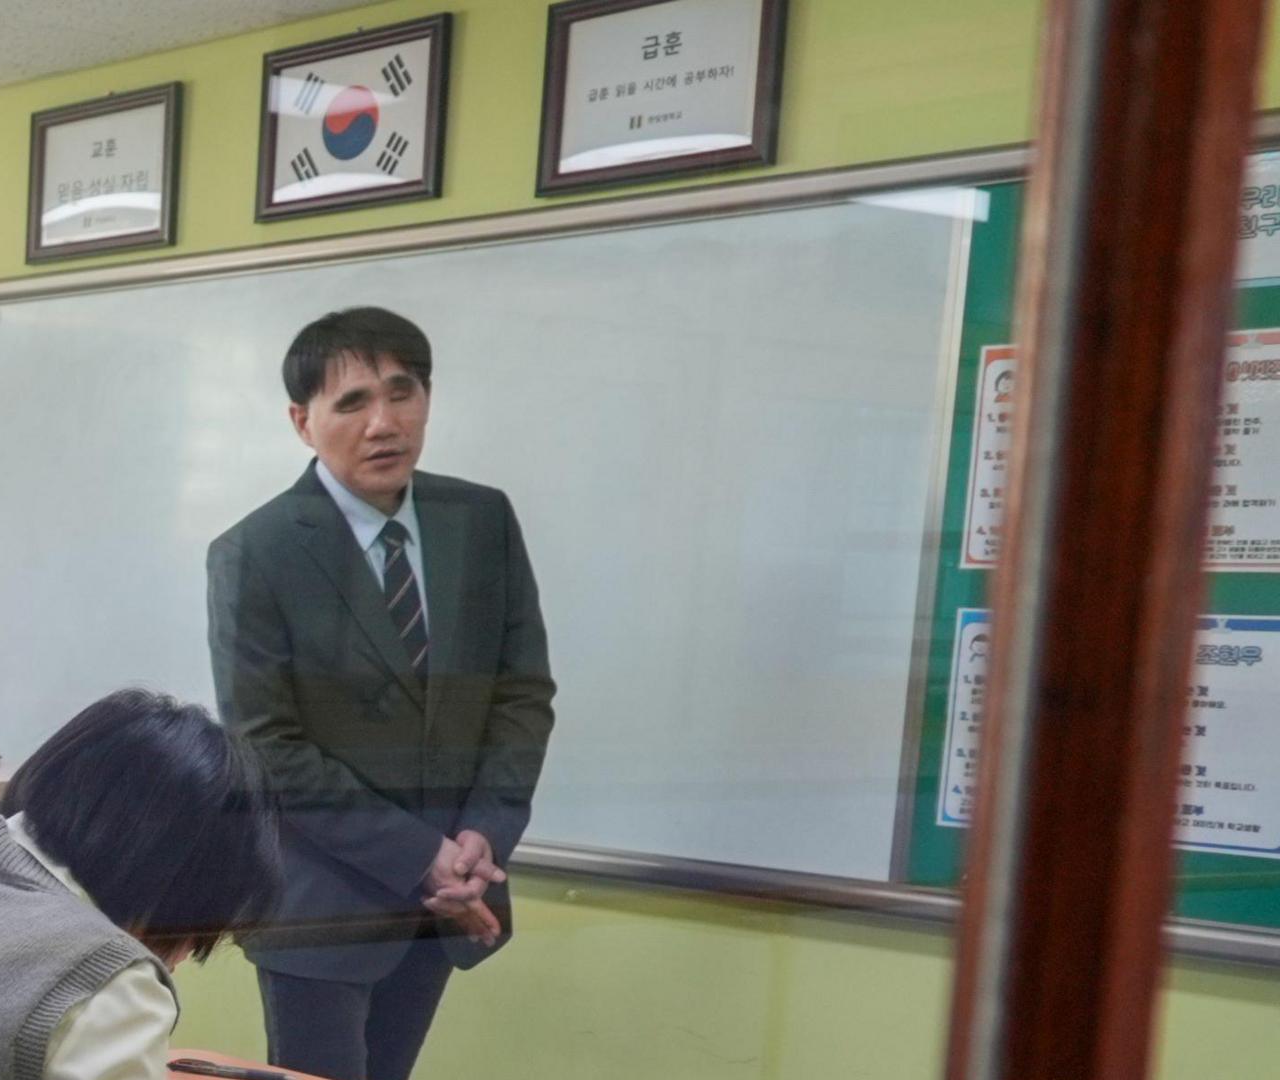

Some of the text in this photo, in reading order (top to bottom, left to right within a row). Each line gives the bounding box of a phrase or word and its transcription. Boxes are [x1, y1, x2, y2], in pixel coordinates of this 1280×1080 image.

[641, 31, 683, 60] 급훈
[643, 75, 678, 92] 시간에
[1196, 644, 1262, 667] 조현우
